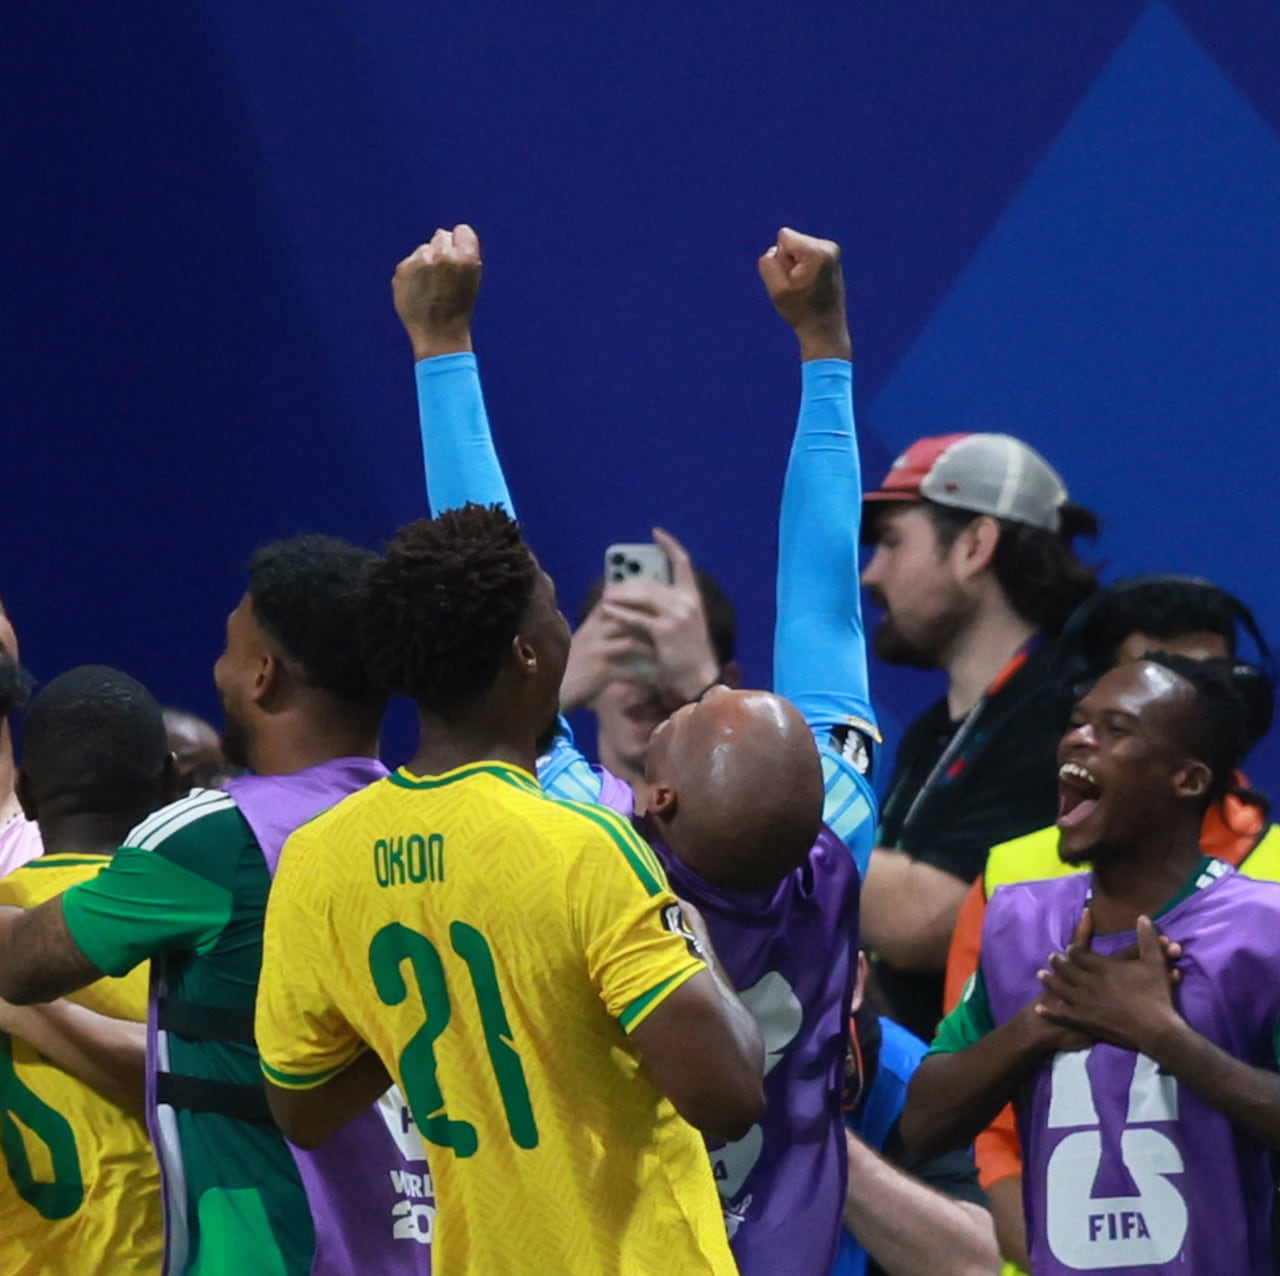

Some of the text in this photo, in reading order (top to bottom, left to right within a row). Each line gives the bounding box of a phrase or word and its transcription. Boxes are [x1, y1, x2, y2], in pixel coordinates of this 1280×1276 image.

[374, 833, 445, 888] OKON
[368, 921, 538, 1159] 21
[1088, 1211, 1151, 1242] FIFA
